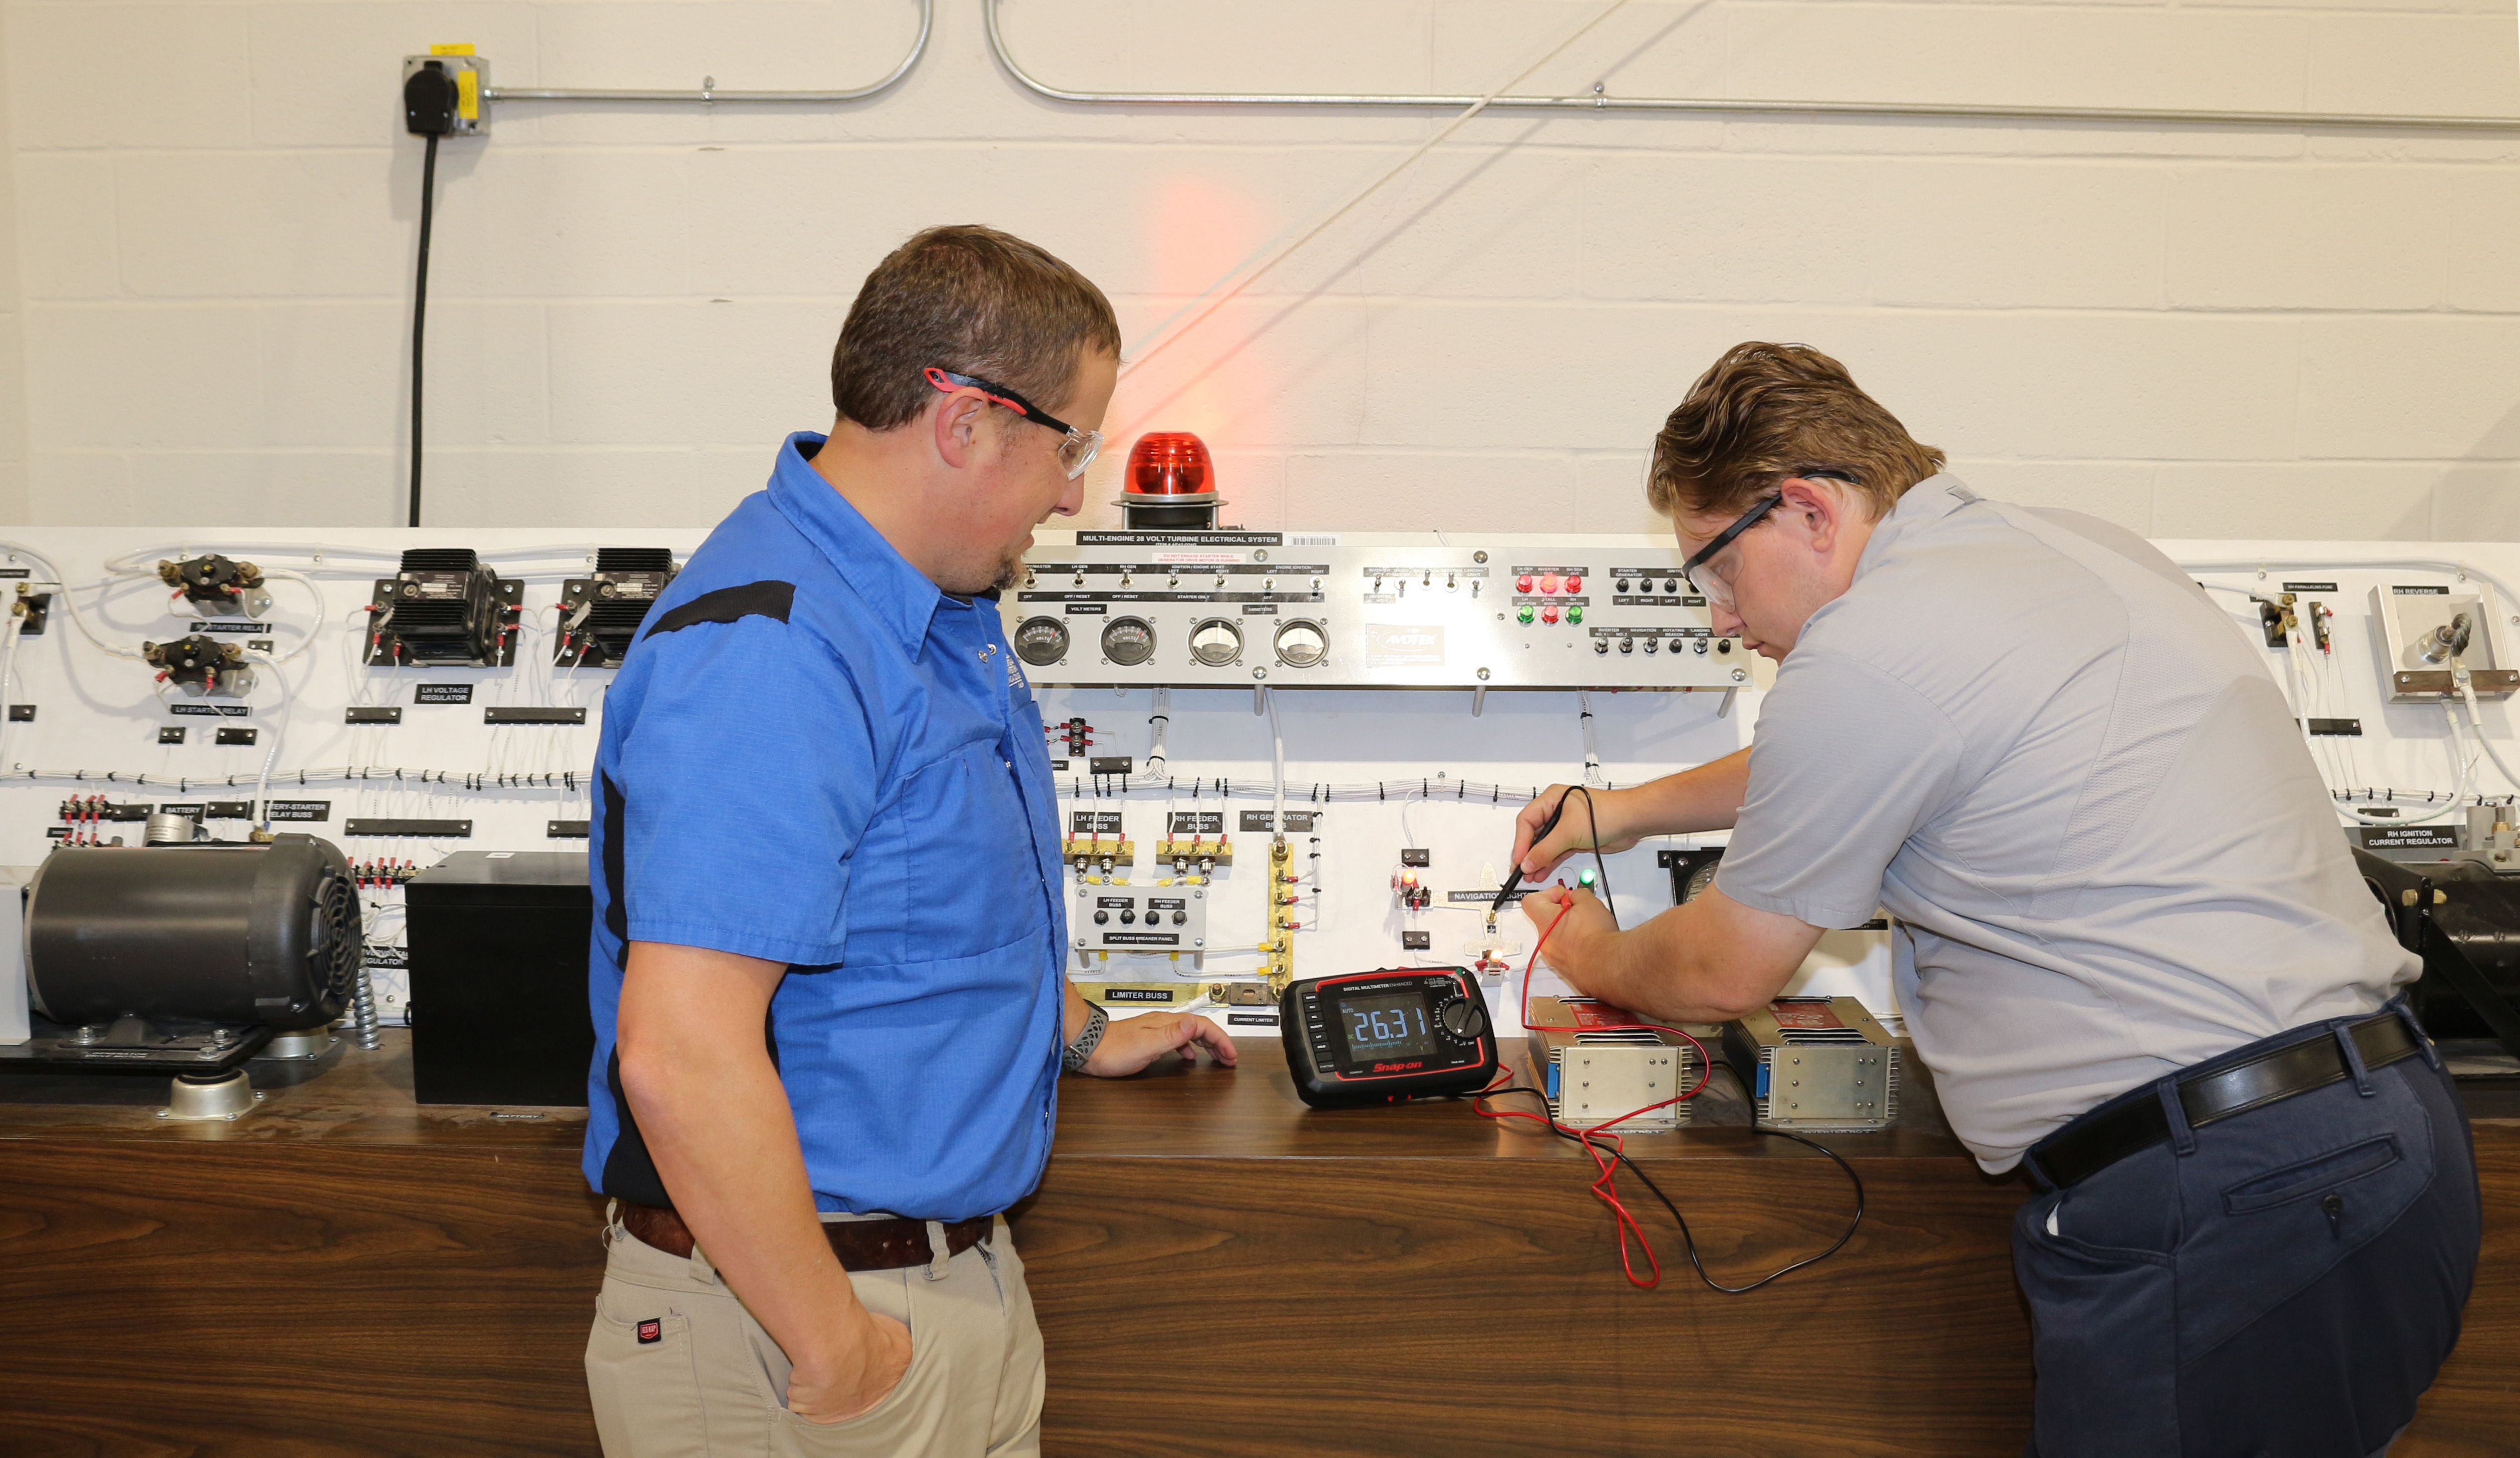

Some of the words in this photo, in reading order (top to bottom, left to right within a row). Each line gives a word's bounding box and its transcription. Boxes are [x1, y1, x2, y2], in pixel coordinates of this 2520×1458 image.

[1385, 633, 1438, 645] AVOTEK
[2406, 837, 2453, 845] REGULATOR
[1353, 1007, 1426, 1041] 26.31
[1373, 1061, 1422, 1072] Snap-on
